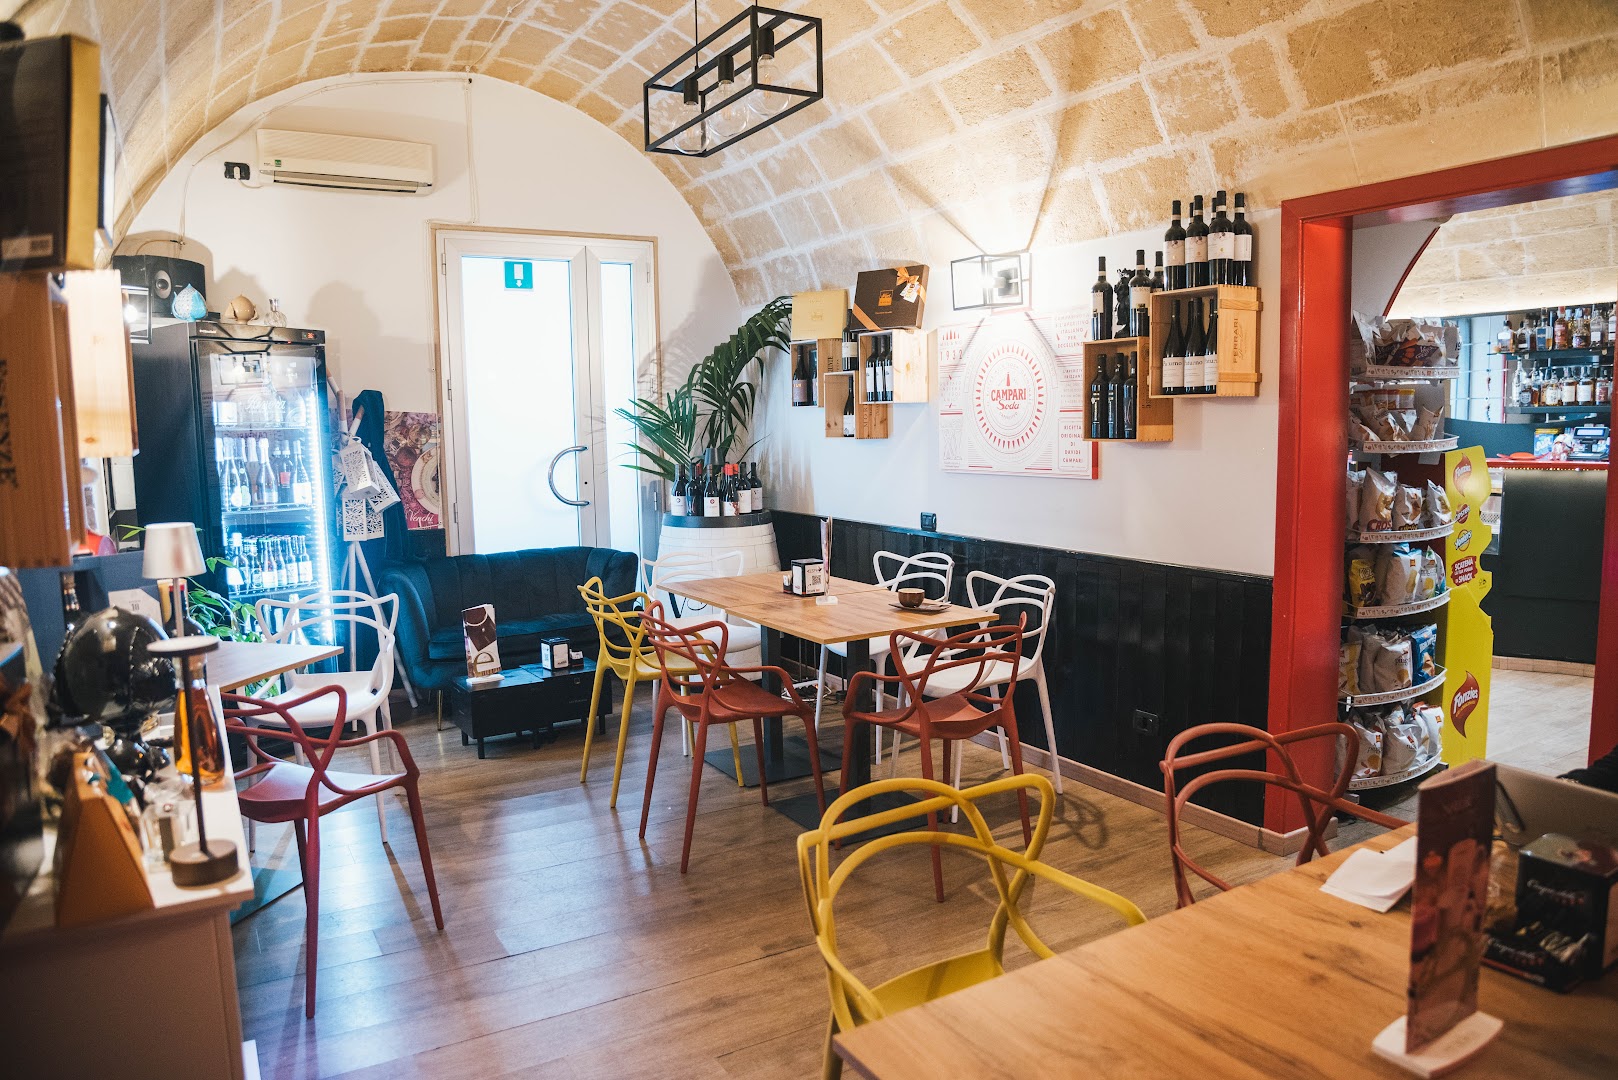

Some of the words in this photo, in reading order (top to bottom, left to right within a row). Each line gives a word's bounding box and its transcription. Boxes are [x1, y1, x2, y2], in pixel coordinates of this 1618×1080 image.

[940, 349, 963, 361] 1932
[991, 388, 1027, 401] CAMPARI
[997, 400, 1020, 411] Soda
[409, 509, 434, 523] Venchi
[1454, 557, 1473, 571] SCATENA
[1458, 572, 1473, 583] SNACK
[1453, 687, 1478, 714] Fonzies
